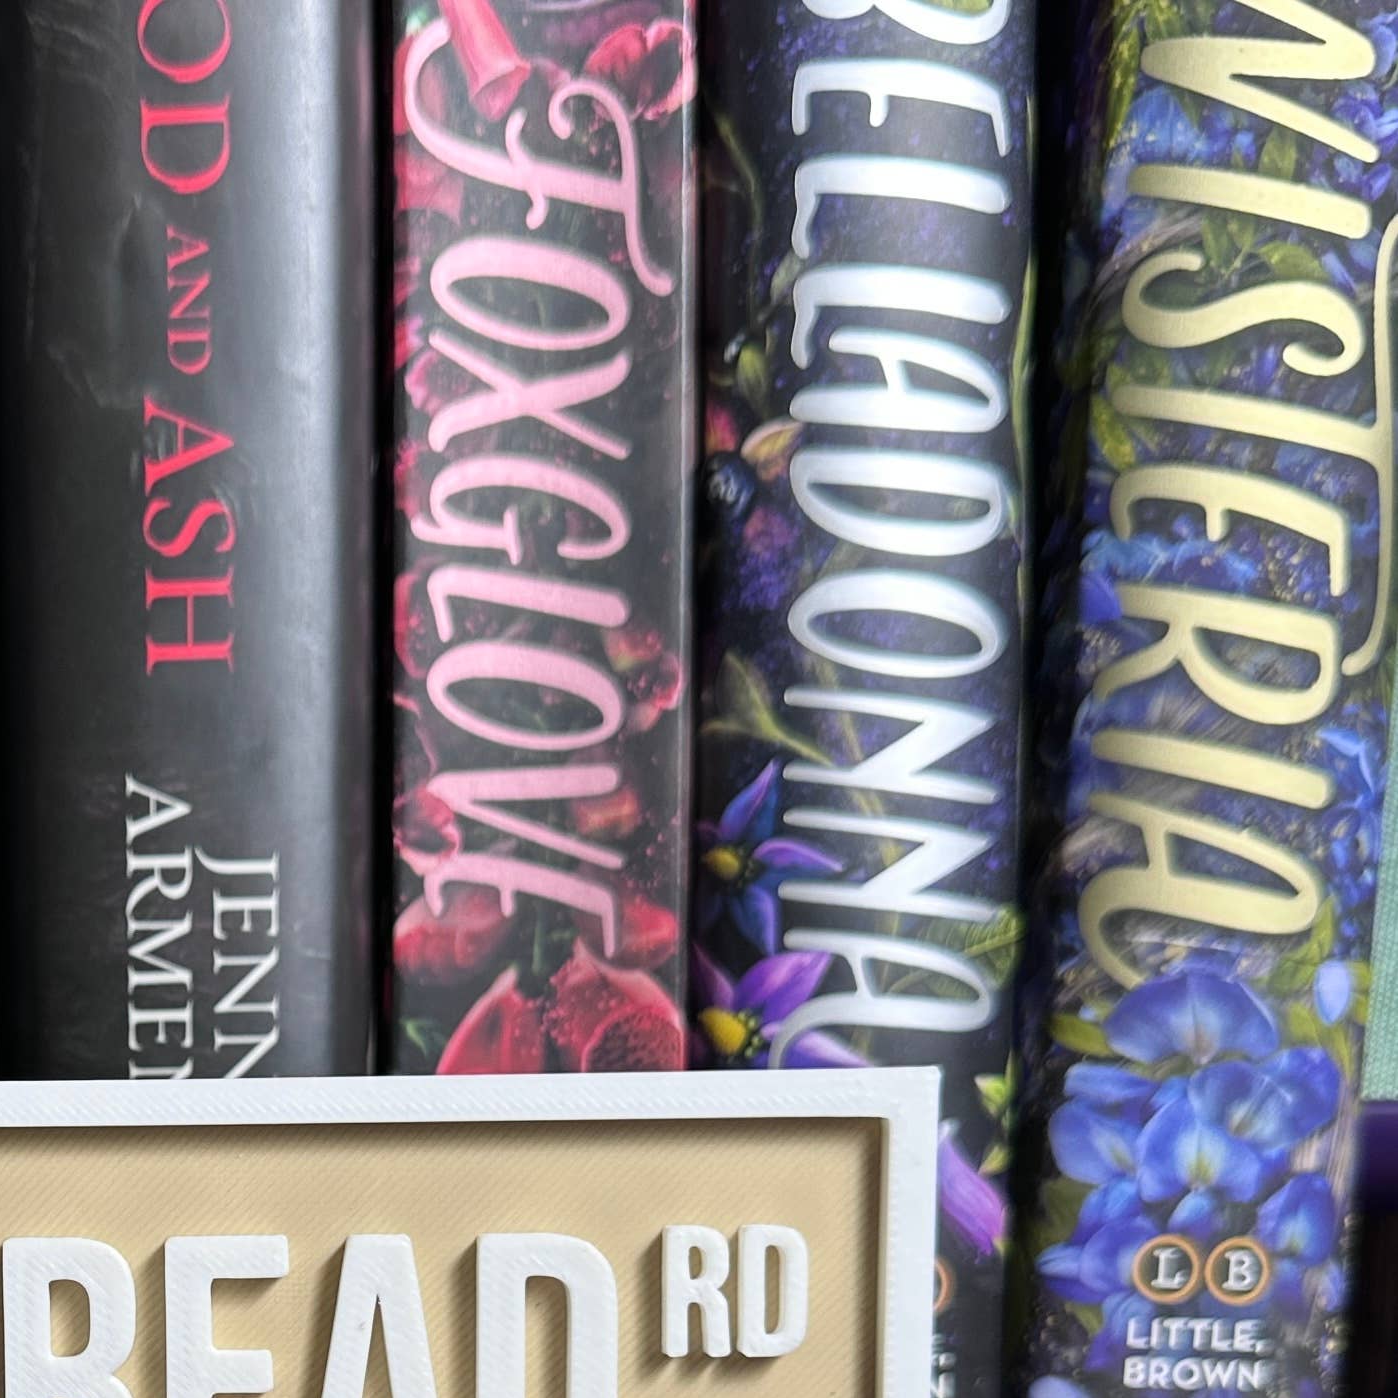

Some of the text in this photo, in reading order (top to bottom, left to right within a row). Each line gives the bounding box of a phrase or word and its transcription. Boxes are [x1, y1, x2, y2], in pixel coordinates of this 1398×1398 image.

[165, 225, 212, 375] AND
[143, 394, 236, 675] ASH
[404, 18, 674, 957] FOXGLOVE
[660, 1223, 809, 1360] RD
[1126, 1316, 1268, 1356] LITTLE,
[1123, 1355, 1273, 1392] BROWN
